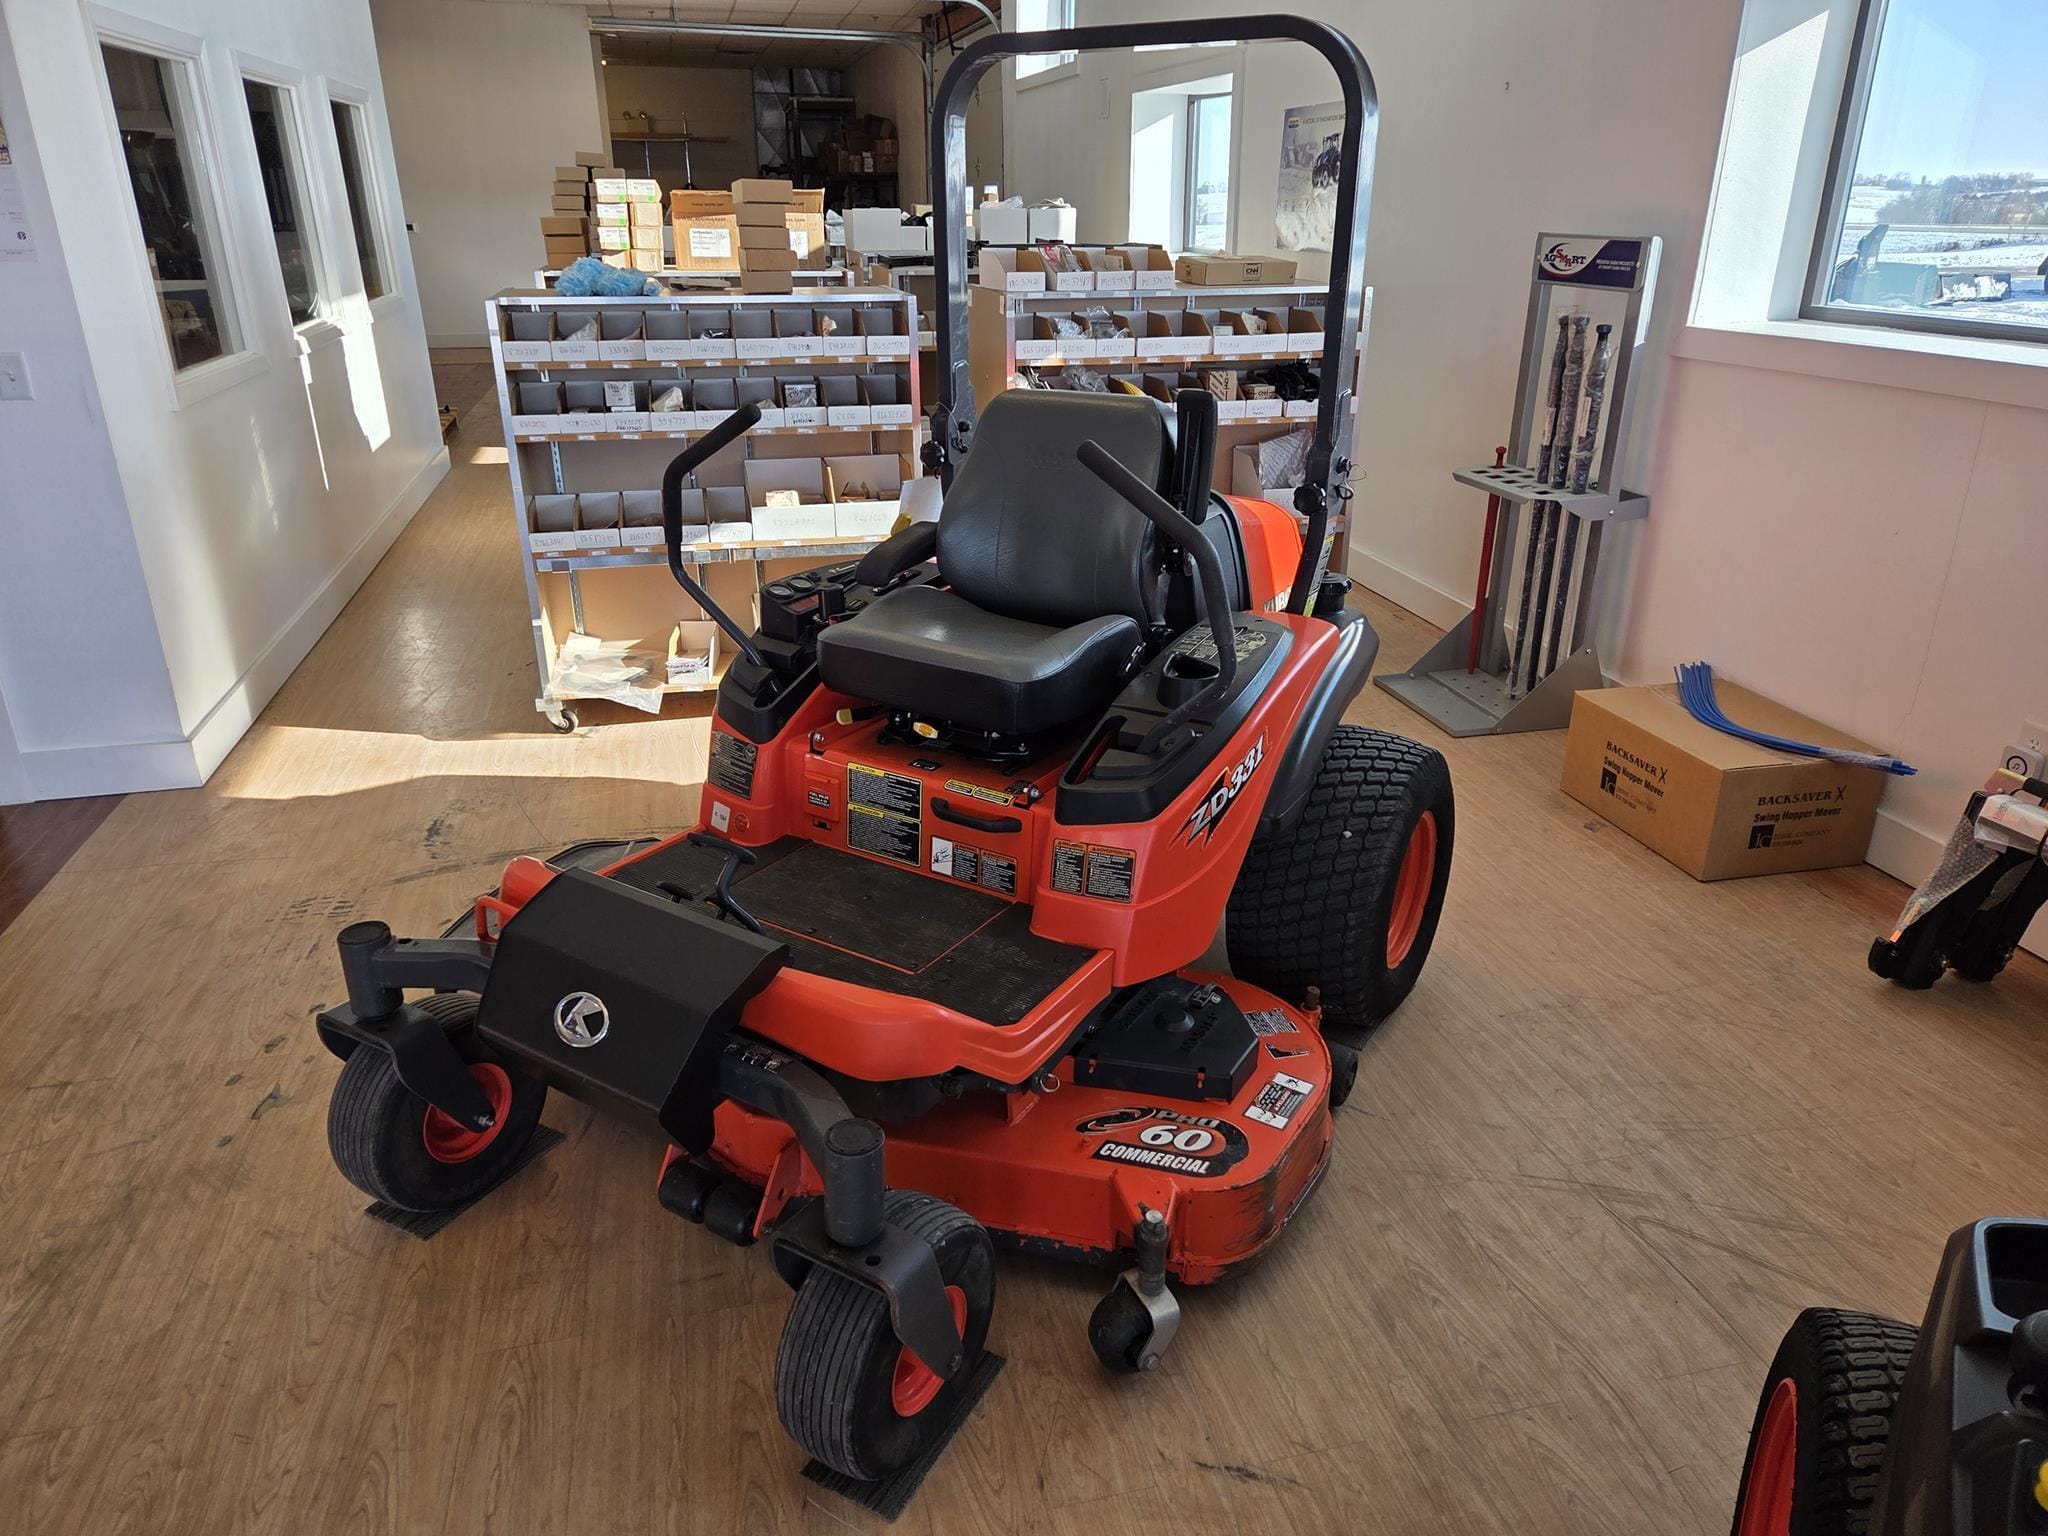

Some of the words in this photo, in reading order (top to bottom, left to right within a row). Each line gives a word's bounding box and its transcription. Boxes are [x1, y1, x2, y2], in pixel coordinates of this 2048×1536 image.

[1606, 740, 1657, 777] BACKSAVER
[1189, 734, 1264, 839] ZD331
[1604, 756, 1621, 774] Swing
[1622, 767, 1643, 785] Hopper
[1643, 779, 1665, 798] Mover
[1758, 791, 1832, 806] BACKSAVER
[1754, 813, 1780, 823] Swing
[1782, 809, 1813, 821] Hopper
[1814, 807, 1842, 818] Mover
[1140, 1125, 1213, 1152] 60
[1100, 1143, 1212, 1175] COMMERCIAL
